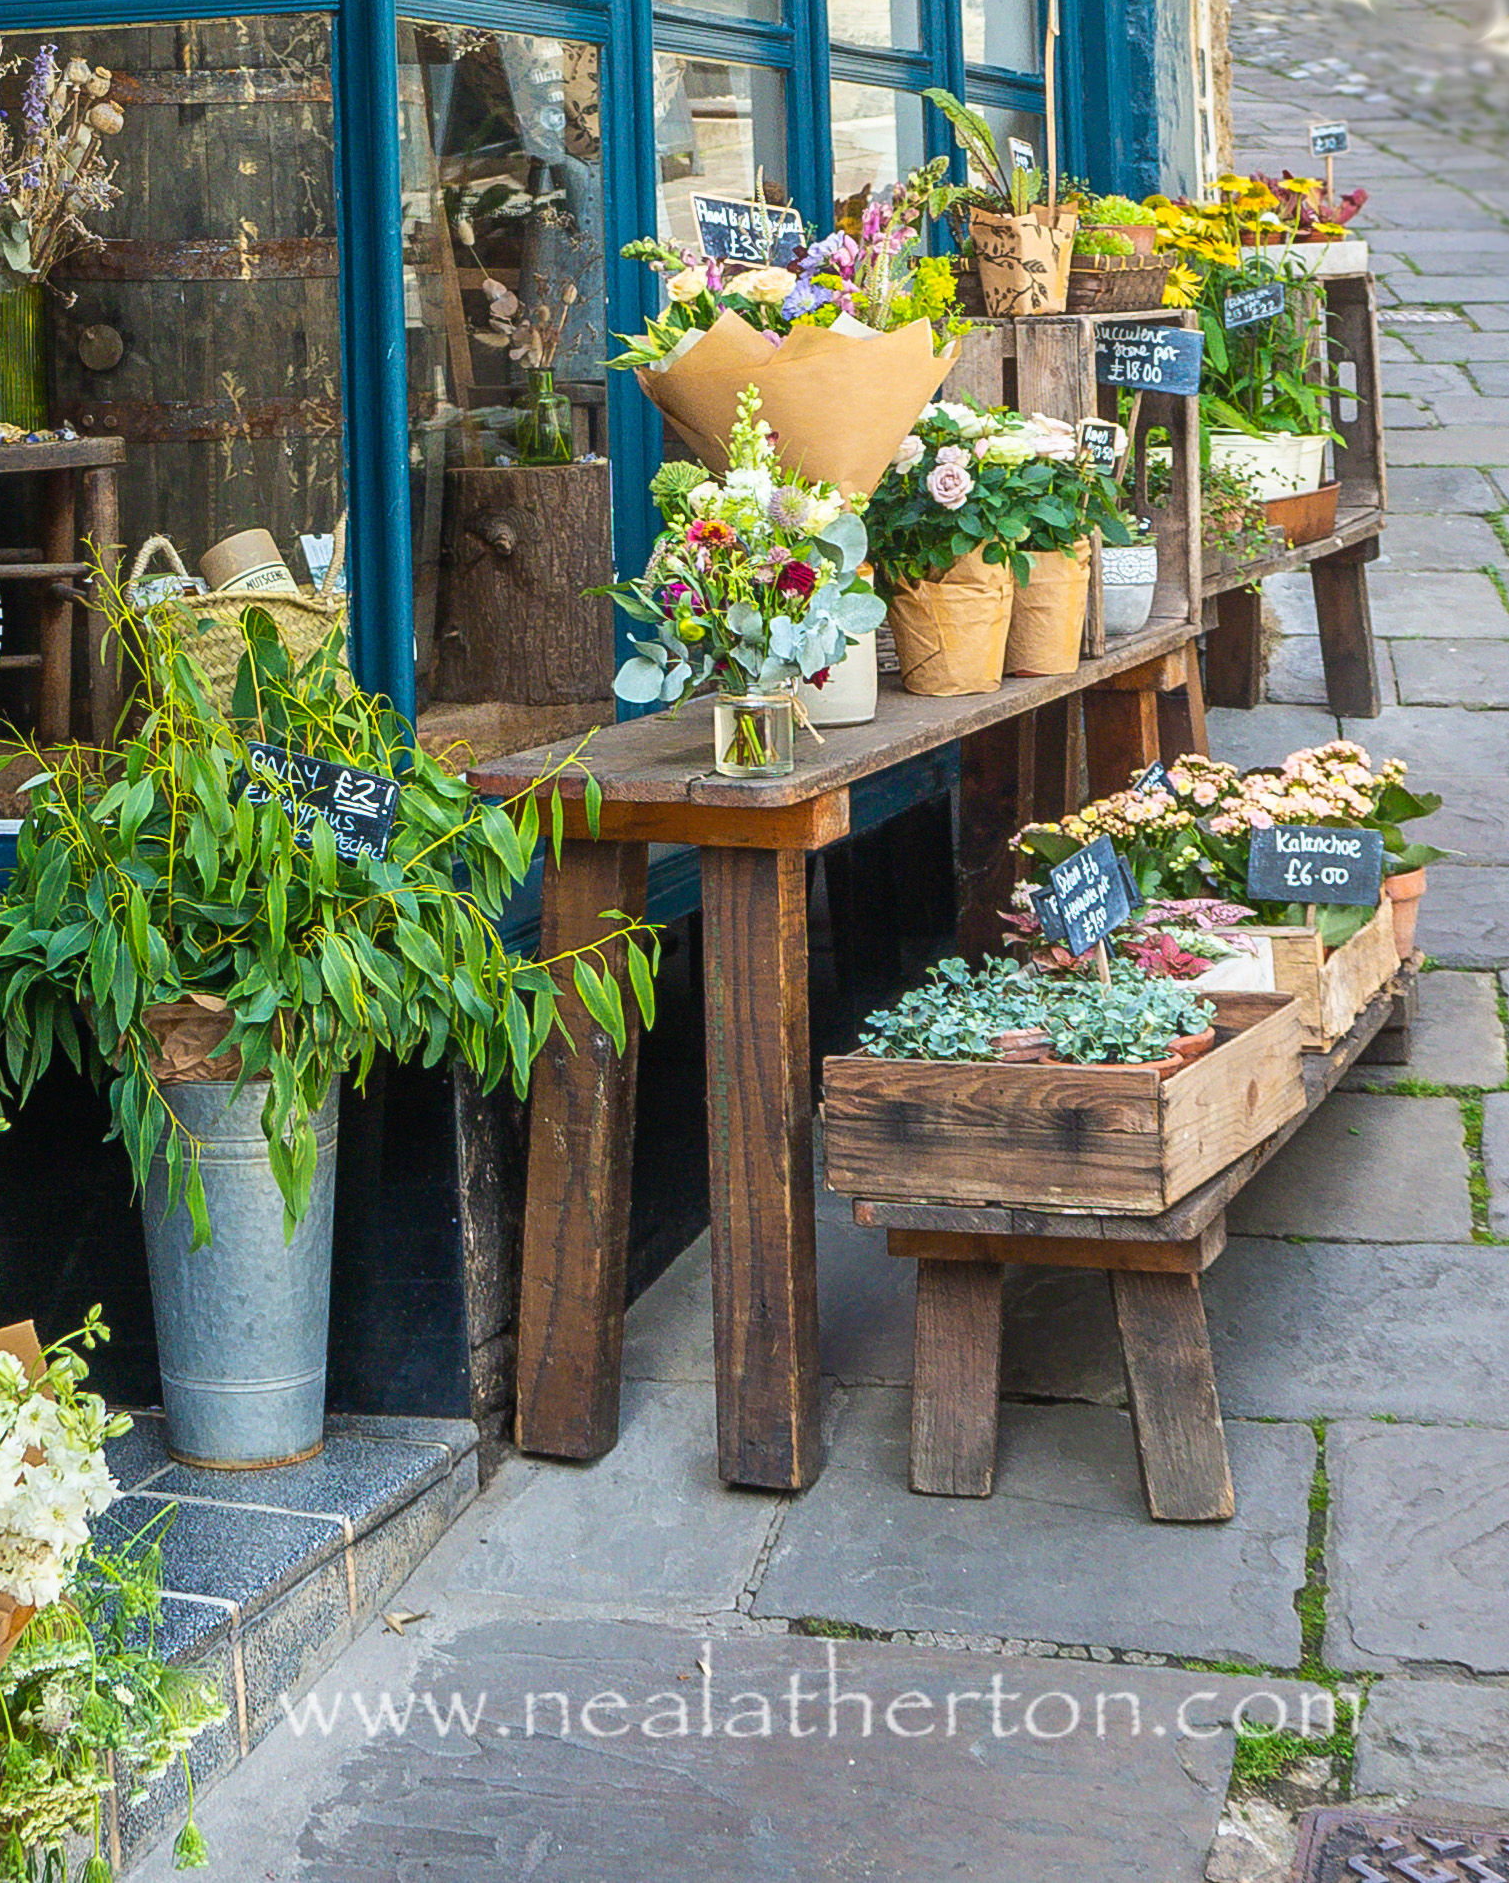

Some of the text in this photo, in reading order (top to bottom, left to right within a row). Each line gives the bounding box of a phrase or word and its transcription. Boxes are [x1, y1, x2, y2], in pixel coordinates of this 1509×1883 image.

[1095, 321, 1171, 344] Succulent
[246, 784, 355, 832] Eualyptus
[1276, 829, 1362, 858] Kalanchoe
